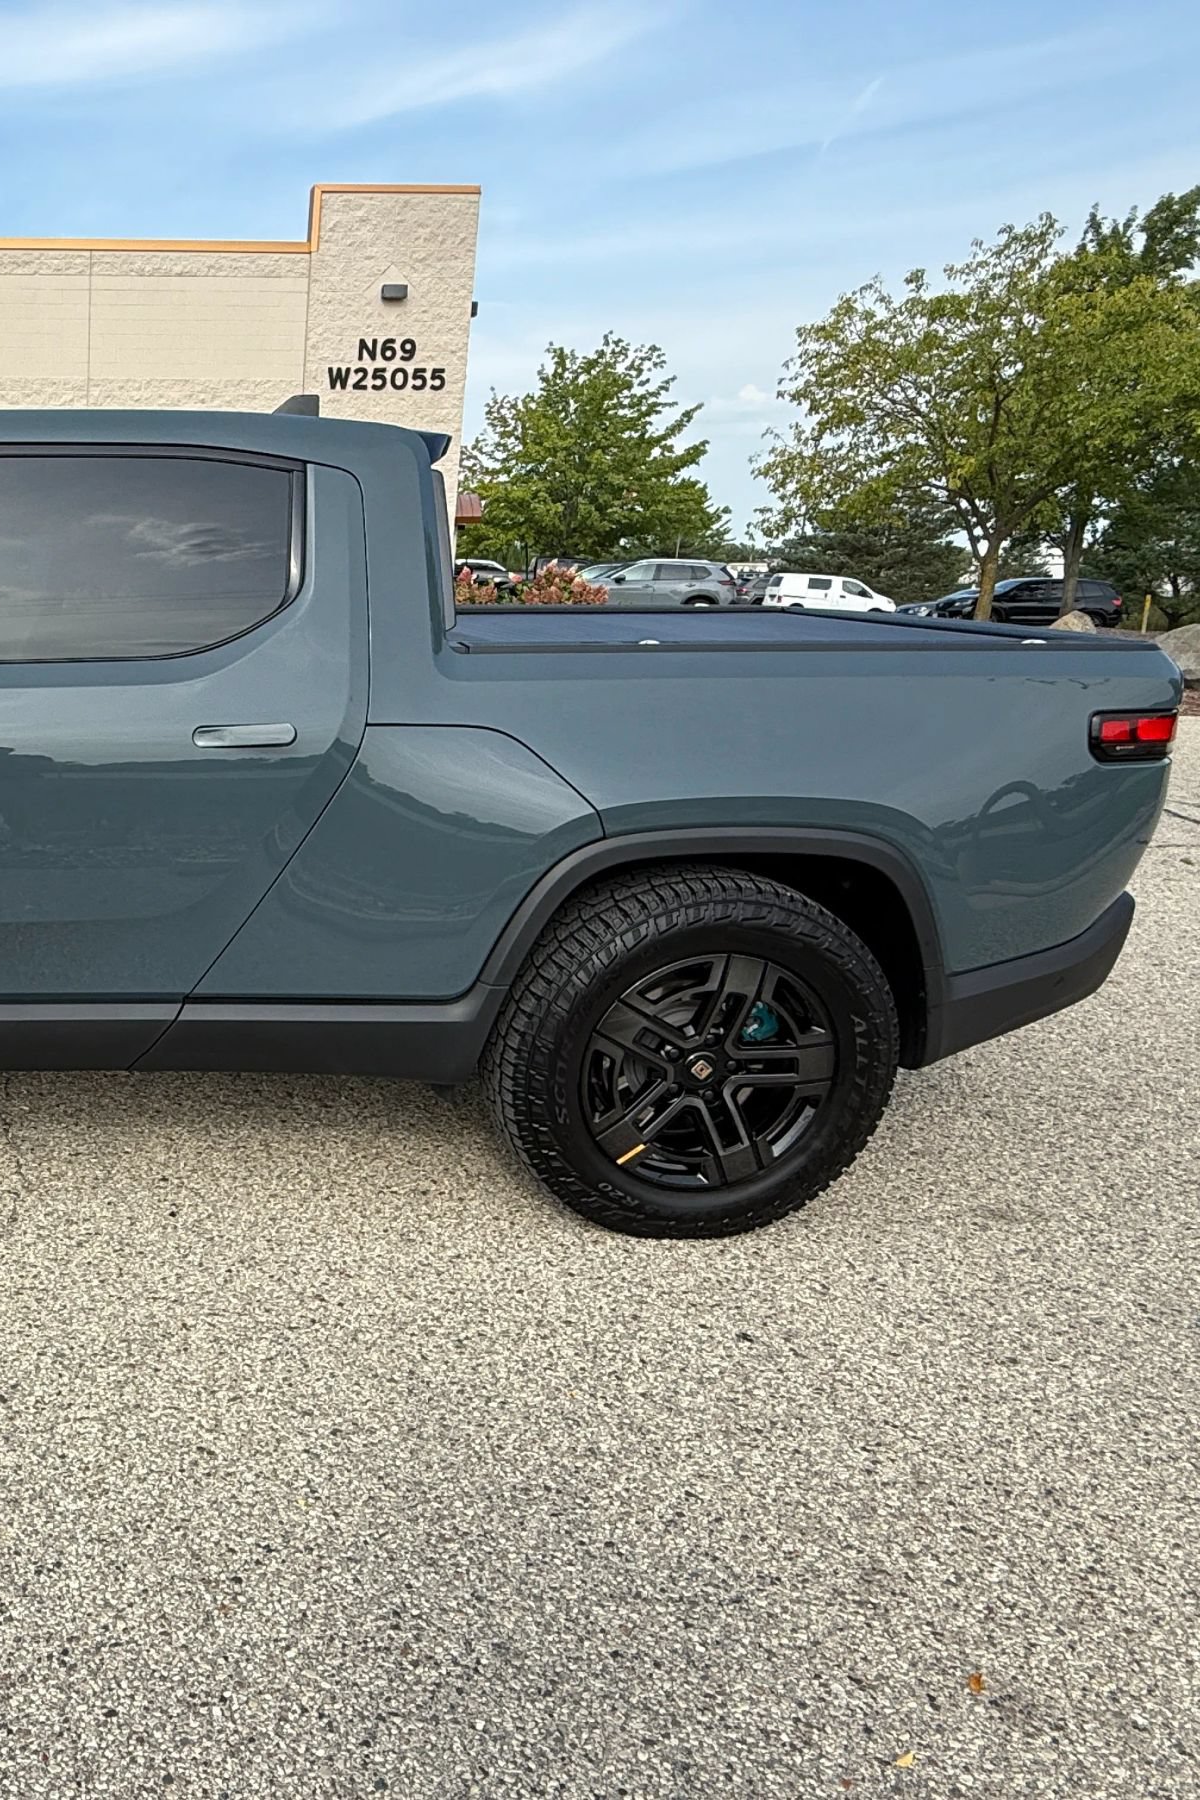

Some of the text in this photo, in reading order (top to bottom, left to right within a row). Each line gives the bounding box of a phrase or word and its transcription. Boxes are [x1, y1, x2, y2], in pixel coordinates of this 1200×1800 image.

[357, 338, 417, 361] N69
[327, 366, 446, 391] W25055
[596, 1180, 640, 1208] R20
